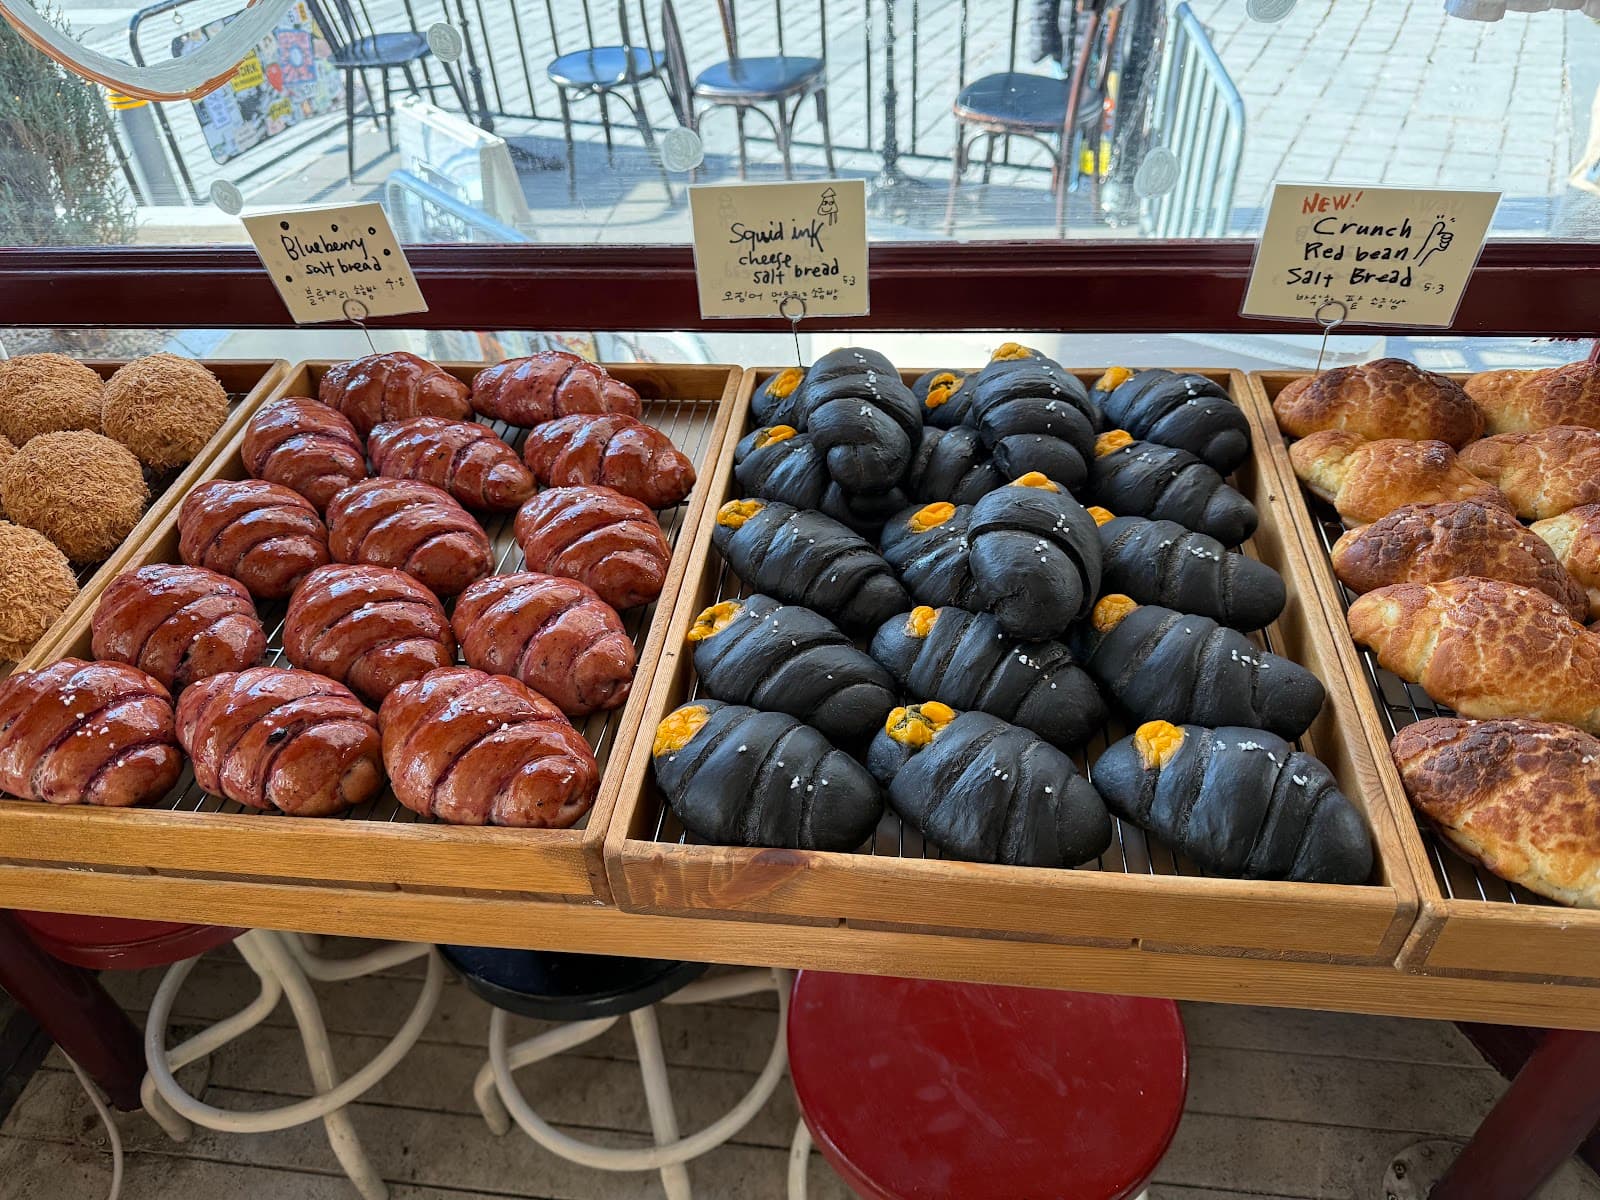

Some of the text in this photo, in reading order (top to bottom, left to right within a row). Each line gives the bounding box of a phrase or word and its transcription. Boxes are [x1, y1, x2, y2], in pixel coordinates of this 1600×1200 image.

[1302, 191, 1364, 214] NEW!
[729, 219, 825, 252] Squid ink
[1313, 216, 1411, 238] Crunch
[280, 234, 368, 261] Blueberry
[1304, 242, 1409, 262] Red bean
[305, 256, 382, 277] salt bread
[738, 251, 792, 270] cheese
[753, 258, 840, 285] salt bread
[1286, 266, 1412, 288] Salt Bread
[722, 291, 763, 303] 오징어
